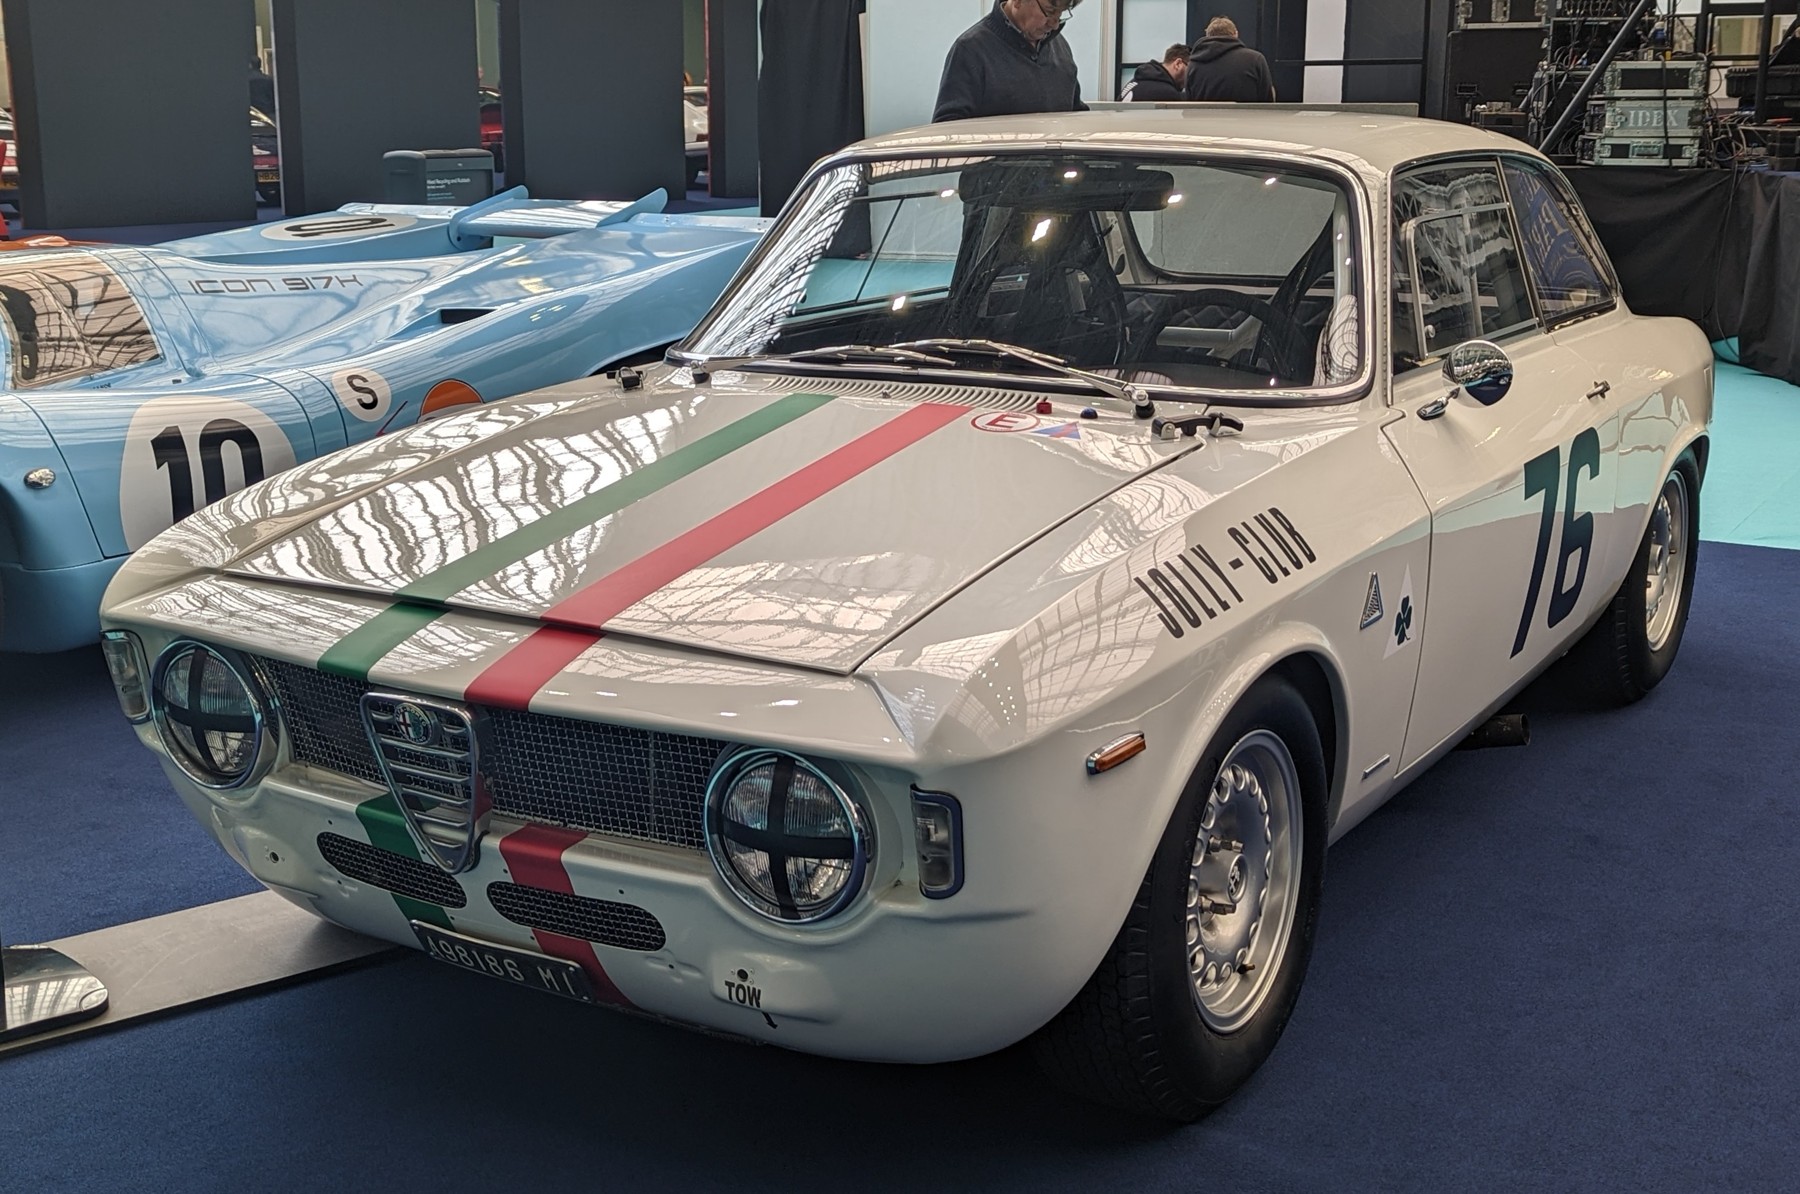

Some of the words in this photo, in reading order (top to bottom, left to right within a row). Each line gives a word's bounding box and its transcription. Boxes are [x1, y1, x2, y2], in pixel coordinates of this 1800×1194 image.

[1628, 109, 1678, 127] IDEX
[188, 278, 276, 295] ICON
[346, 374, 379, 410] S
[985, 411, 1028, 429] E
[150, 418, 265, 525] 10
[1509, 426, 1601, 660] 76
[537, 966, 576, 995] MI
[724, 980, 761, 1009] TOW
